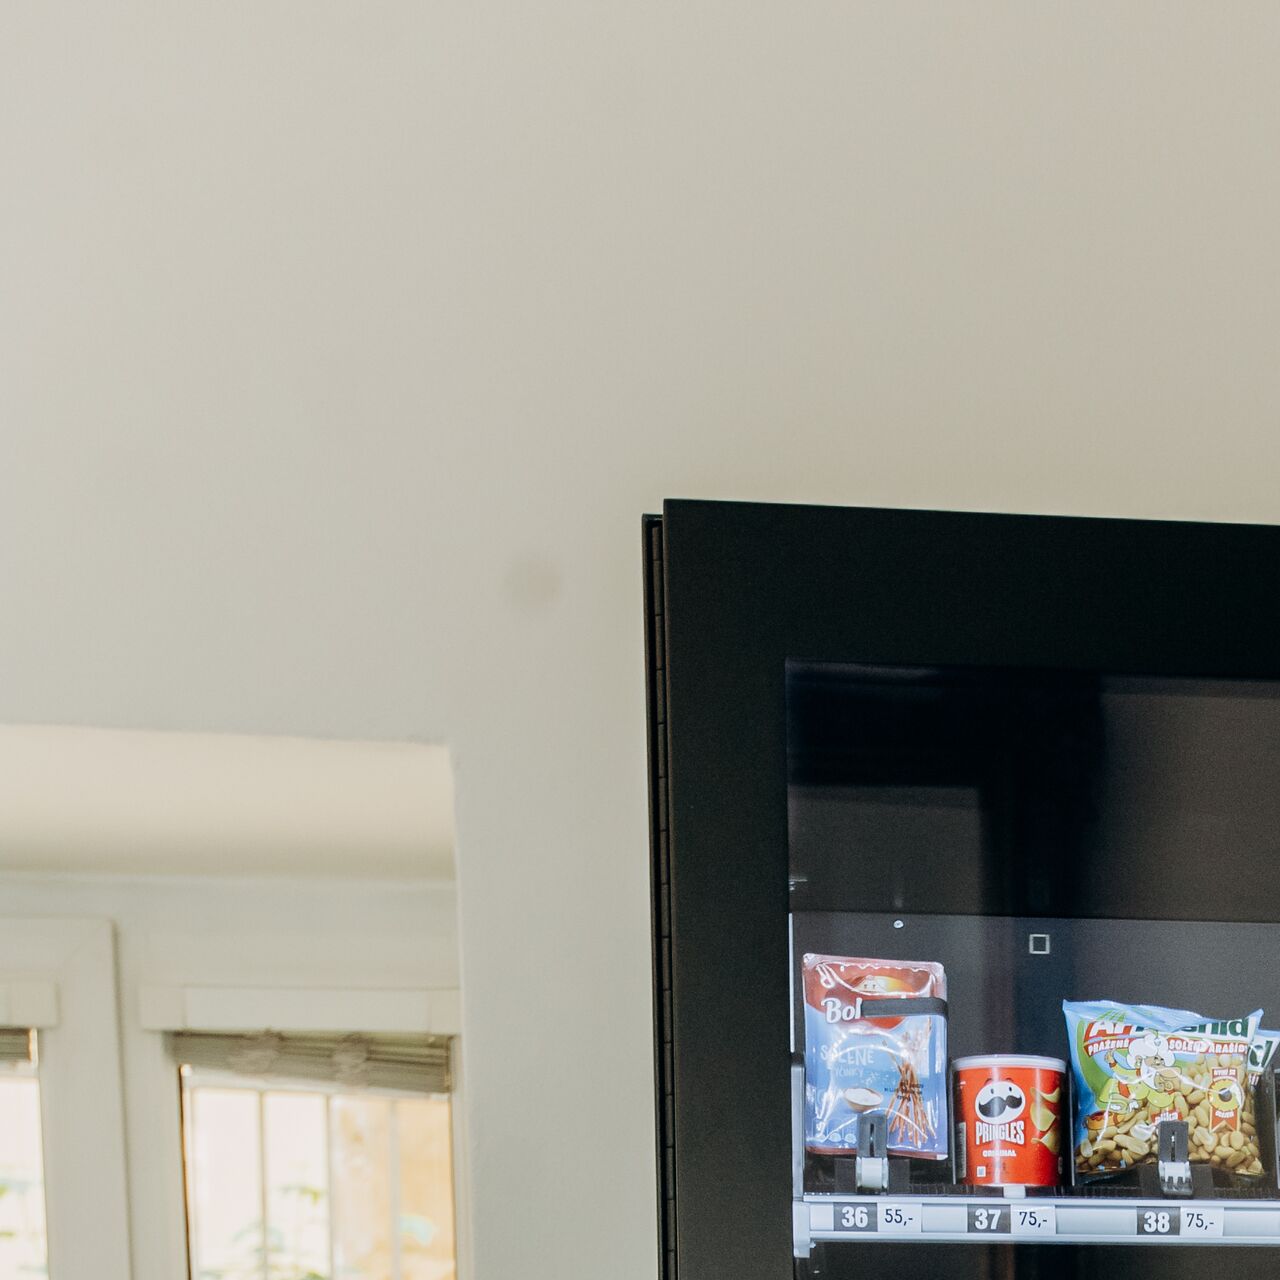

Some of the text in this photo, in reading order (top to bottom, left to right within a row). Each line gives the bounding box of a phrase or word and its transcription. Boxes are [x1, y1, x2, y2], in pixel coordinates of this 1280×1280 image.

[975, 1120, 1025, 1146] PRINGLES
[841, 1206, 913, 1228] 36 55,-
[974, 1208, 1048, 1230] 37 75,-
[1143, 1211, 1214, 1233] 38 75,-
